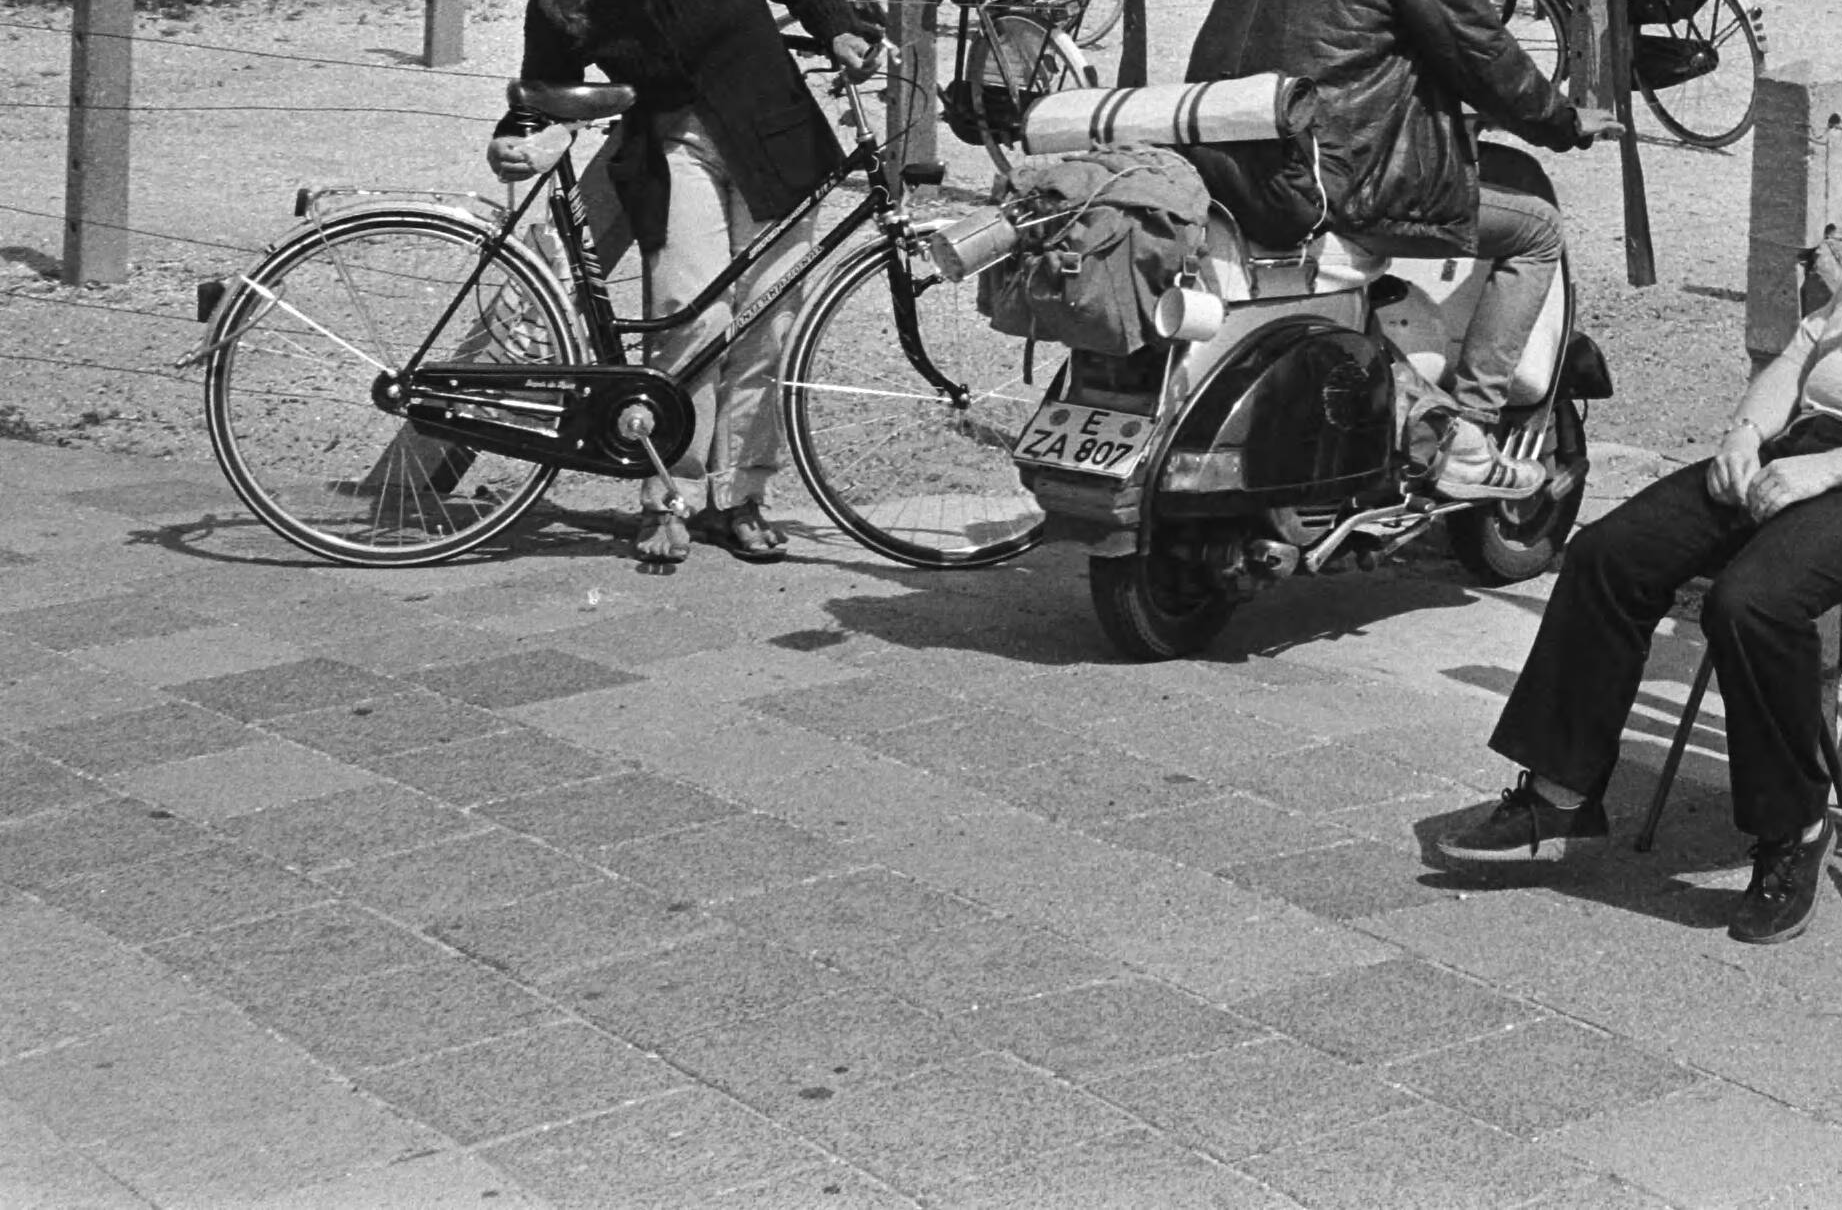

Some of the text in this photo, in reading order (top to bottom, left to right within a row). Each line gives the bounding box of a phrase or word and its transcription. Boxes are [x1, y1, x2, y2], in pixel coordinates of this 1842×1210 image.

[1079, 410, 1111, 436] E
[1021, 428, 1134, 470] ZA 807
